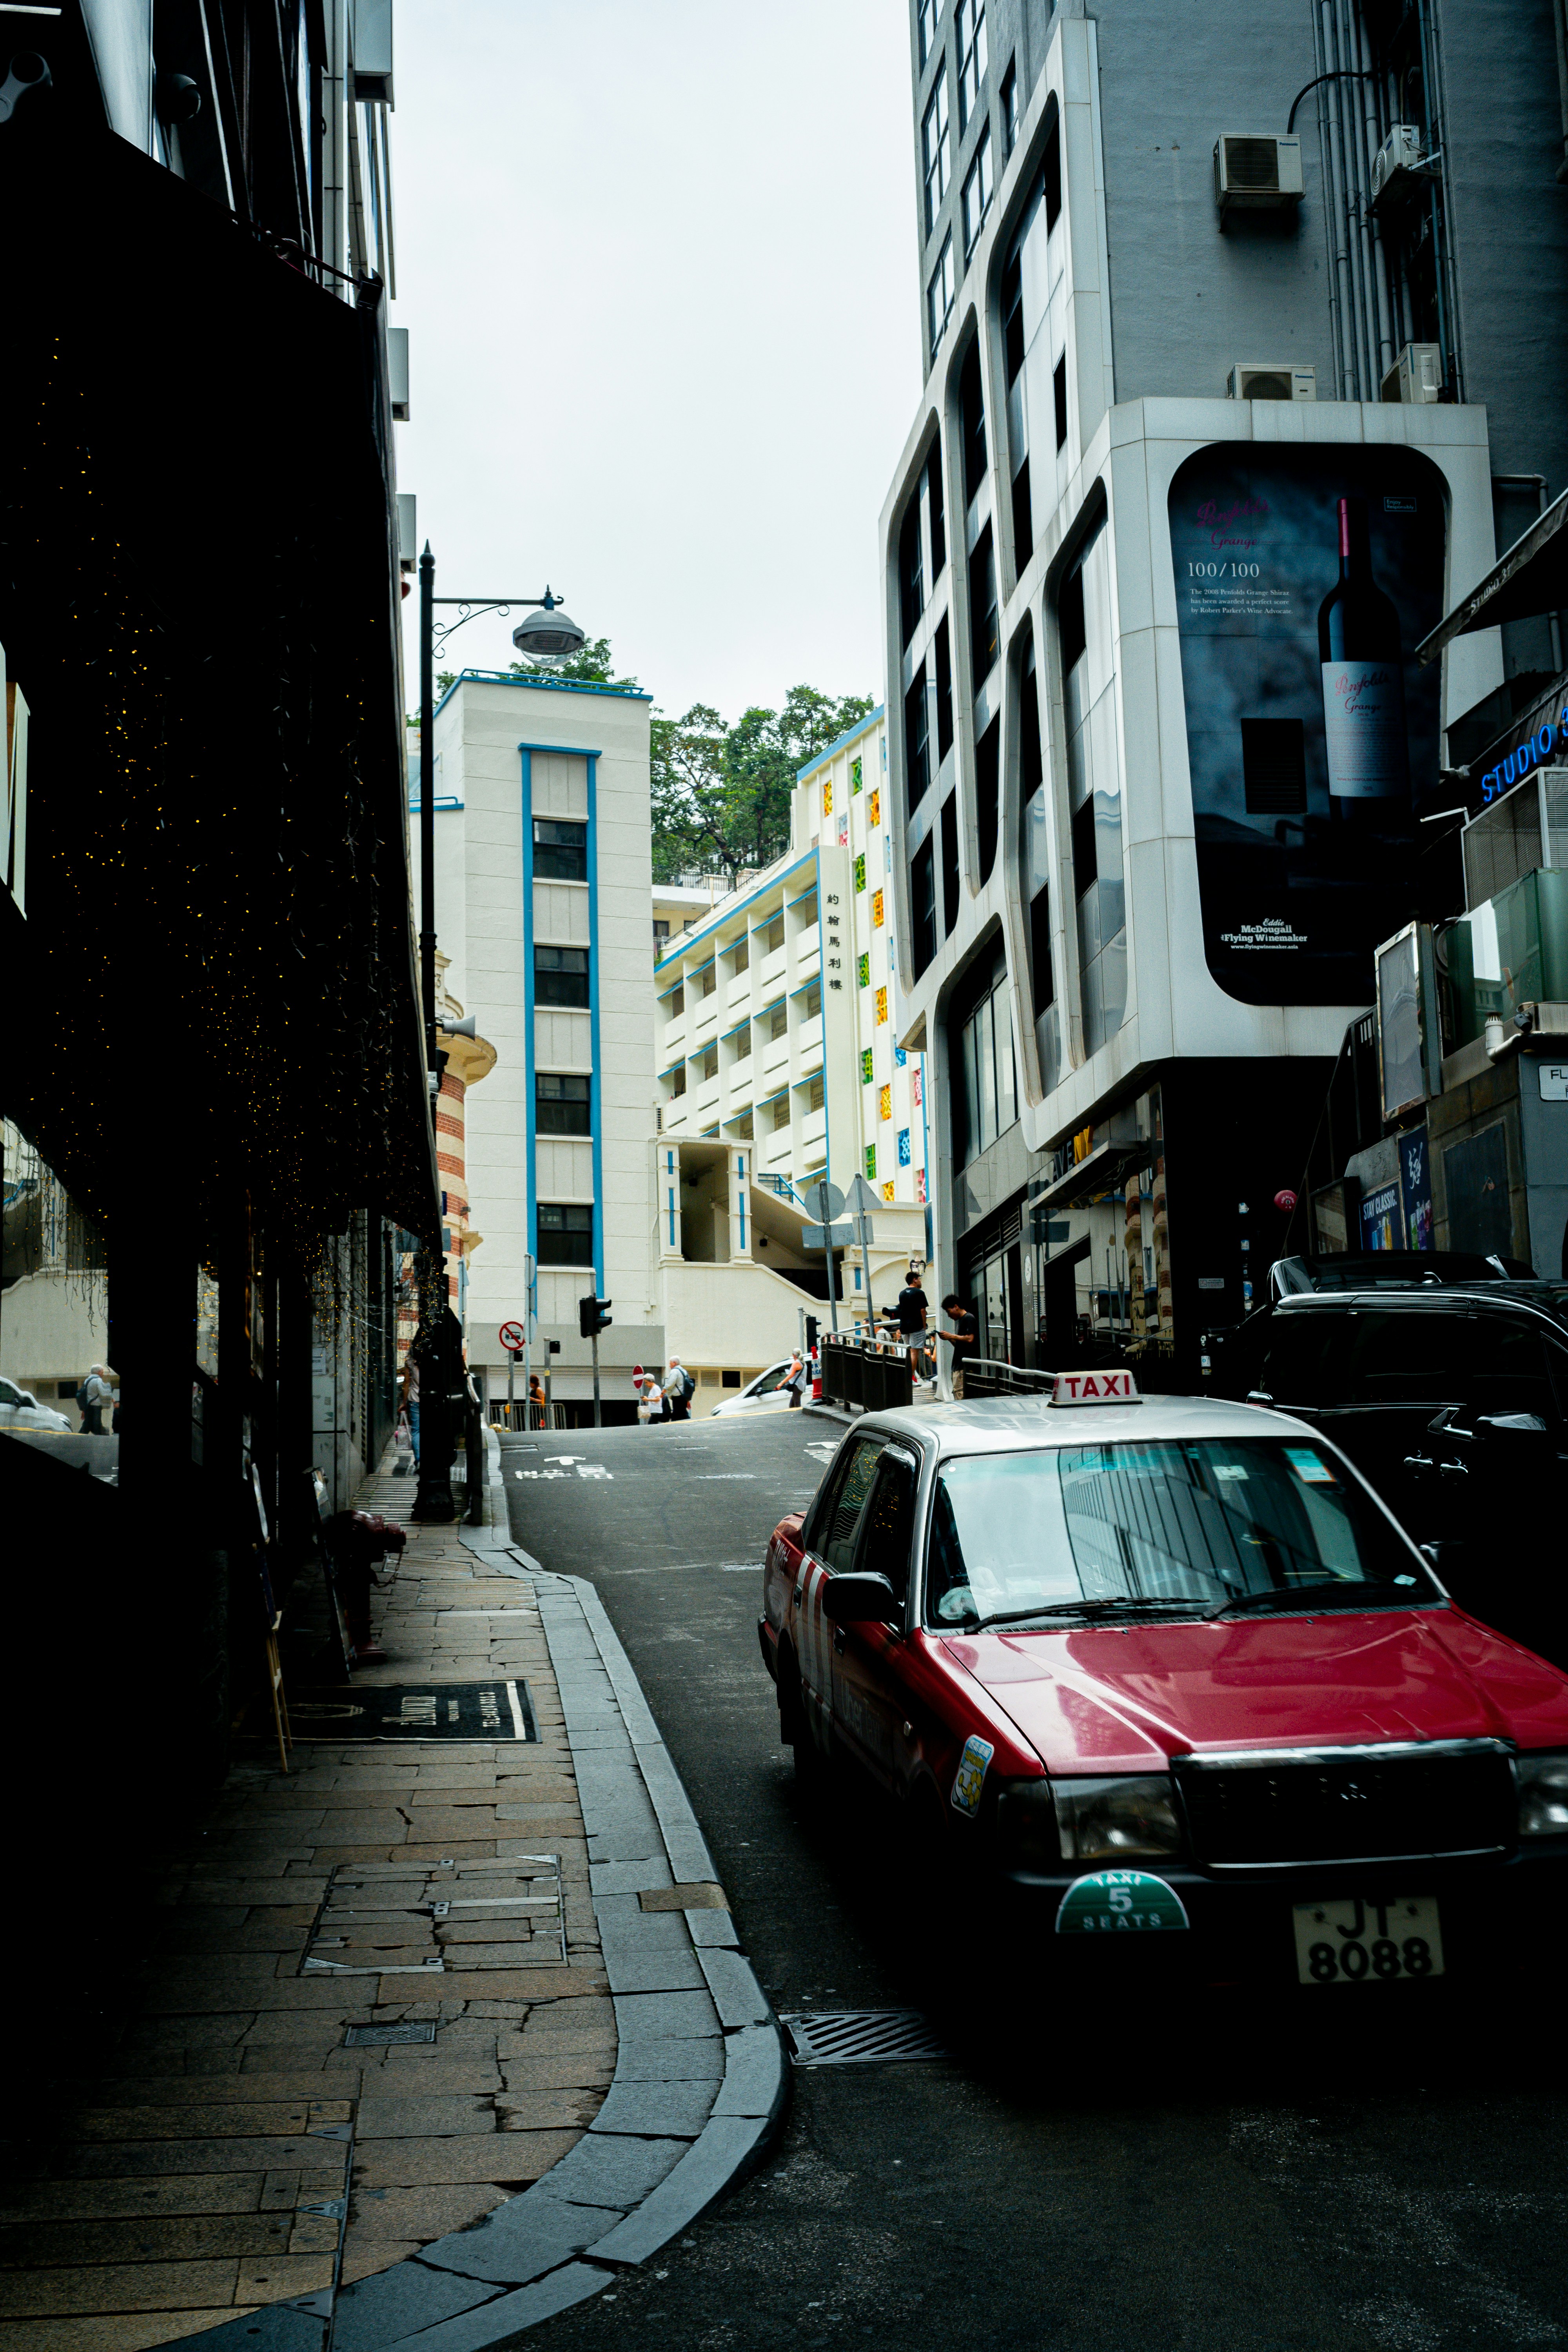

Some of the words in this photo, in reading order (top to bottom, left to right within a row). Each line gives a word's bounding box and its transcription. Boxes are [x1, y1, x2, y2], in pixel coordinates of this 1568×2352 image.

[1197, 495, 1270, 528] Penfolds
[1211, 527, 1257, 550] Grange
[1188, 563, 1259, 577] 100/100
[1335, 672, 1390, 697] Penfolds
[1345, 696, 1381, 714] Grange
[1481, 724, 1554, 803] STUDIO
[1224, 934, 1254, 943] Flying
[1241, 925, 1292, 935] McDougall
[1363, 1196, 1375, 1220] STAY
[1375, 1189, 1397, 1214] CLASSIC.
[1065, 1375, 1130, 1398] TAXI
[1090, 1873, 1142, 1887] TAXI
[1108, 1887, 1133, 1913] 5
[1083, 1913, 1161, 1929] SEATS
[1309, 1937, 1433, 1981] 8088
